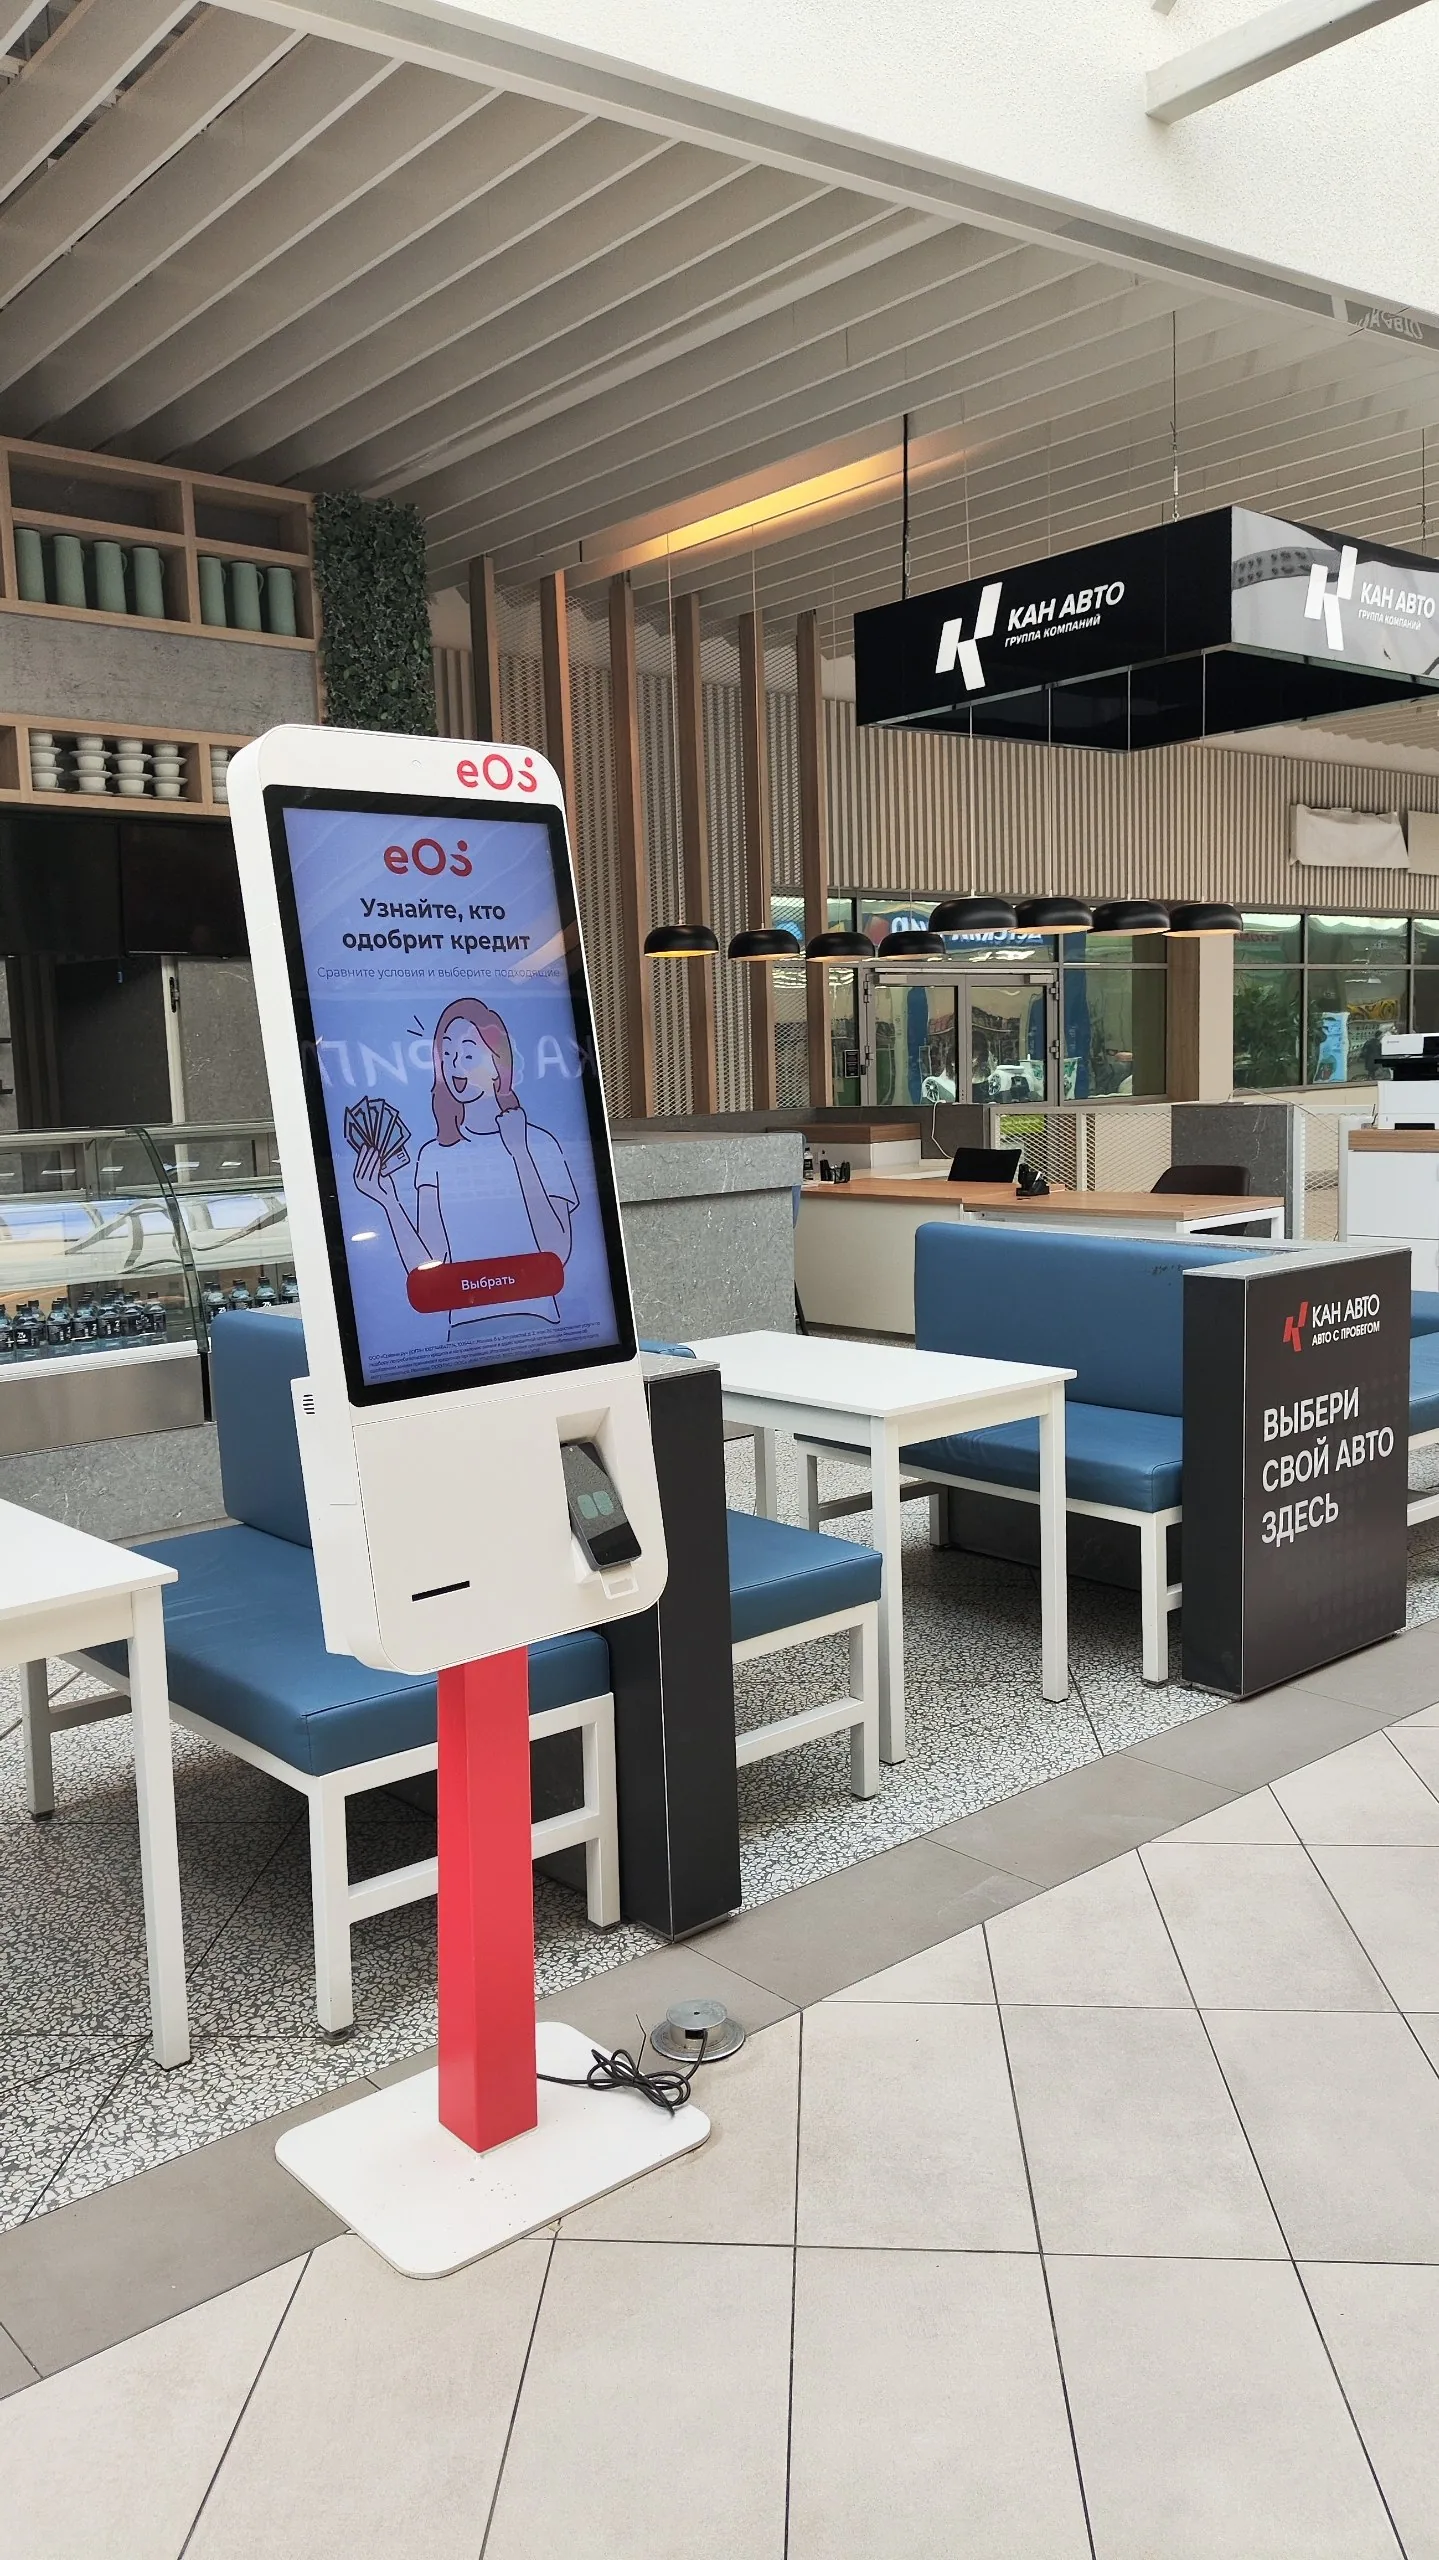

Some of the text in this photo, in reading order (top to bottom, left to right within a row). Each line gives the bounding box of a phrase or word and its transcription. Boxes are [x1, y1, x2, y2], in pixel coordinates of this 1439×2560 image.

[1007, 581, 1125, 632] КАН АВТО
[1360, 582, 1436, 620] КАН АВТО
[1004, 613, 1101, 648] ГРУППА КОМПАНИЙ
[1358, 608, 1421, 631] ГРУППА КОМПАНИЙ
[360, 897, 506, 923] Узнайте, кто
[342, 928, 530, 955] одобрит кредит
[317, 966, 376, 980] Сравните
[378, 967, 425, 980] условия
[428, 968, 436, 977] и
[438, 967, 492, 980] выберите
[461, 1275, 515, 1291] Выбрать
[1311, 1293, 1381, 1329] КАН АВТО
[1311, 1320, 1381, 1347] АВТО С ПРОБЕГОМ
[1262, 1386, 1360, 1443] ВЫБЕРИ
[1262, 1425, 1395, 1493] СВОЙ АВТО
[1261, 1491, 1340, 1547] ЗДЕСЬ
